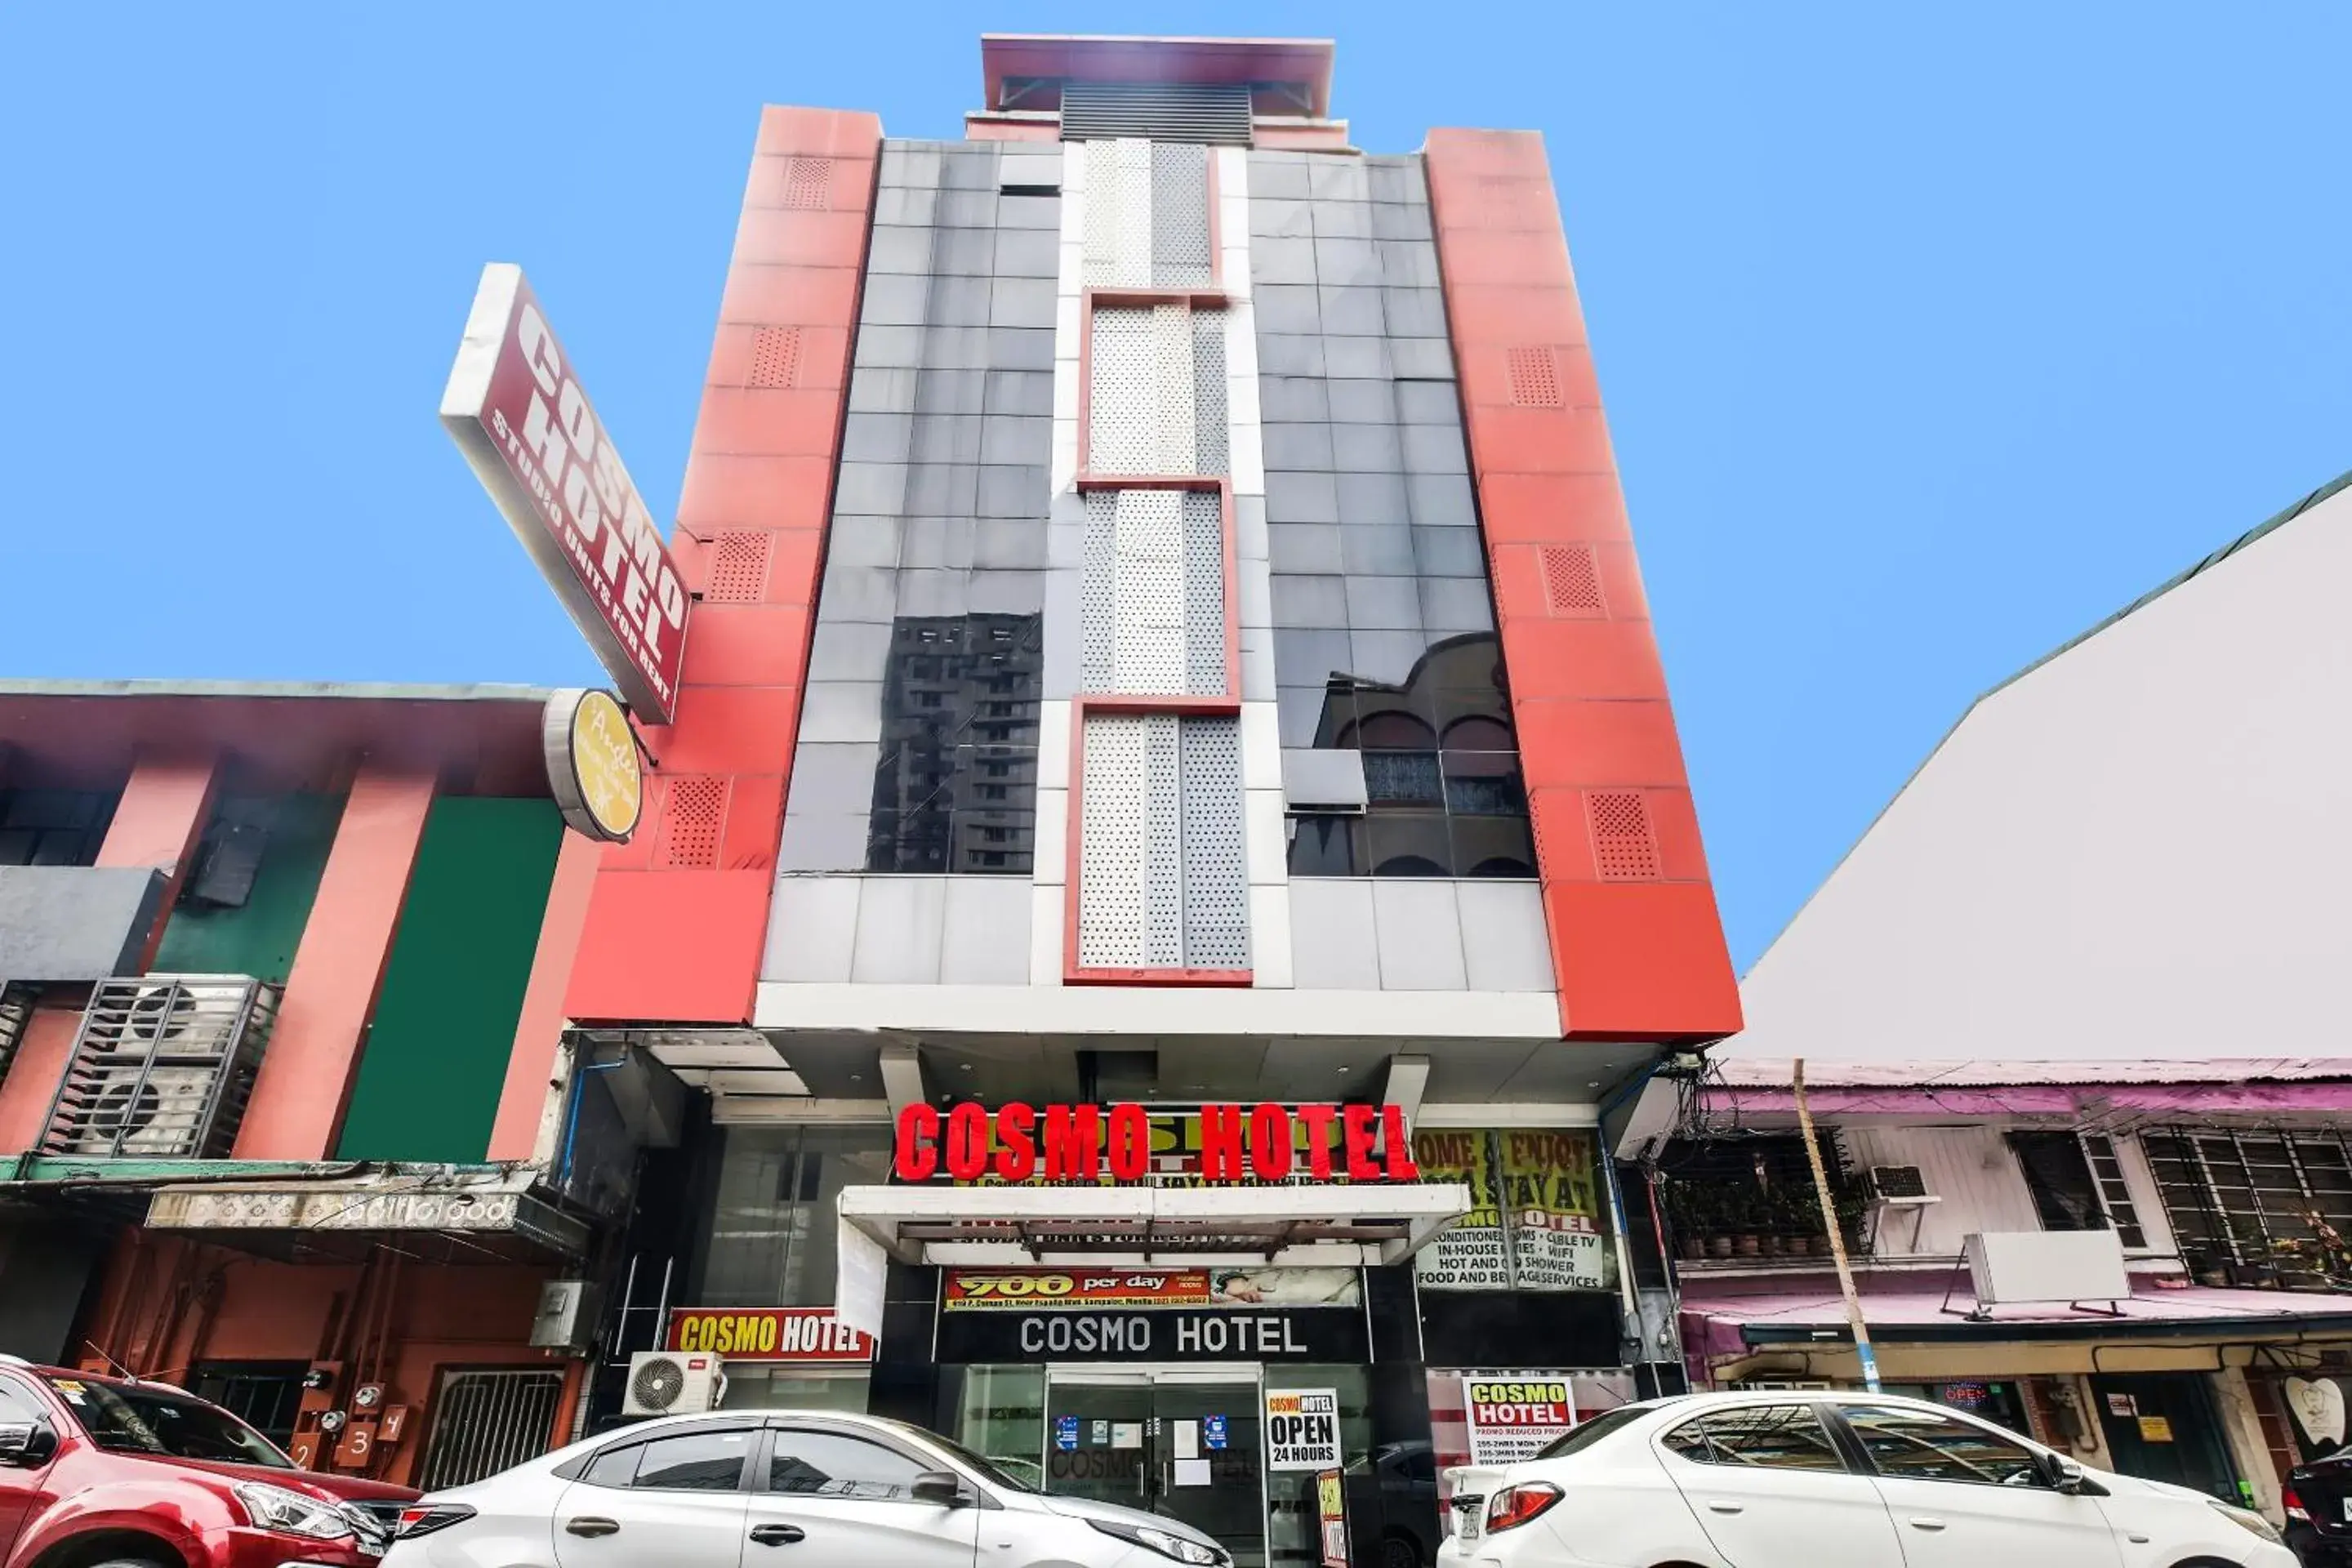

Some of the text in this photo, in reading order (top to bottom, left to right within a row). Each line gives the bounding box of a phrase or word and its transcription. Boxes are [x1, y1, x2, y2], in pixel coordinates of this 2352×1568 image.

[518, 302, 684, 630] COSMO
[523, 387, 662, 664] HOTEL
[492, 408, 670, 702] STUDIO UNITS FOR RENT
[896, 1102, 1148, 1182] COSMO
[1200, 1102, 1419, 1182] HOTEL
[1411, 1133, 1477, 1169] OME
[1553, 1177, 1588, 1212] AT
[1437, 1243, 1498, 1255] IN-HOUSE
[1548, 1245, 1574, 1258] WIFI
[1580, 1237, 1596, 1248] TV
[1439, 1258, 1467, 1269] HOT
[1470, 1258, 1499, 1269] AND
[1525, 1257, 1575, 1272] SHOWER
[1083, 1275, 1120, 1291] per
[1125, 1275, 1166, 1290] day
[1419, 1272, 1455, 1284] FOOD
[1458, 1272, 1487, 1284] AND
[679, 1315, 861, 1352] COSMO HOTEL
[1021, 1316, 1307, 1353] COSMO HOTEL
[1472, 1383, 1566, 1403] COSMO
[1269, 1396, 1333, 1413] COSMO HOTEL
[1479, 1404, 1564, 1423] HOTEL
[386, 1415, 400, 1434] 4
[1271, 1415, 1334, 1445] OPEN
[1505, 1428, 1543, 1436] REDUCED
[350, 1431, 368, 1454] 3
[297, 1445, 309, 1470] 2
[1274, 1446, 1334, 1462] 24 HOURS
